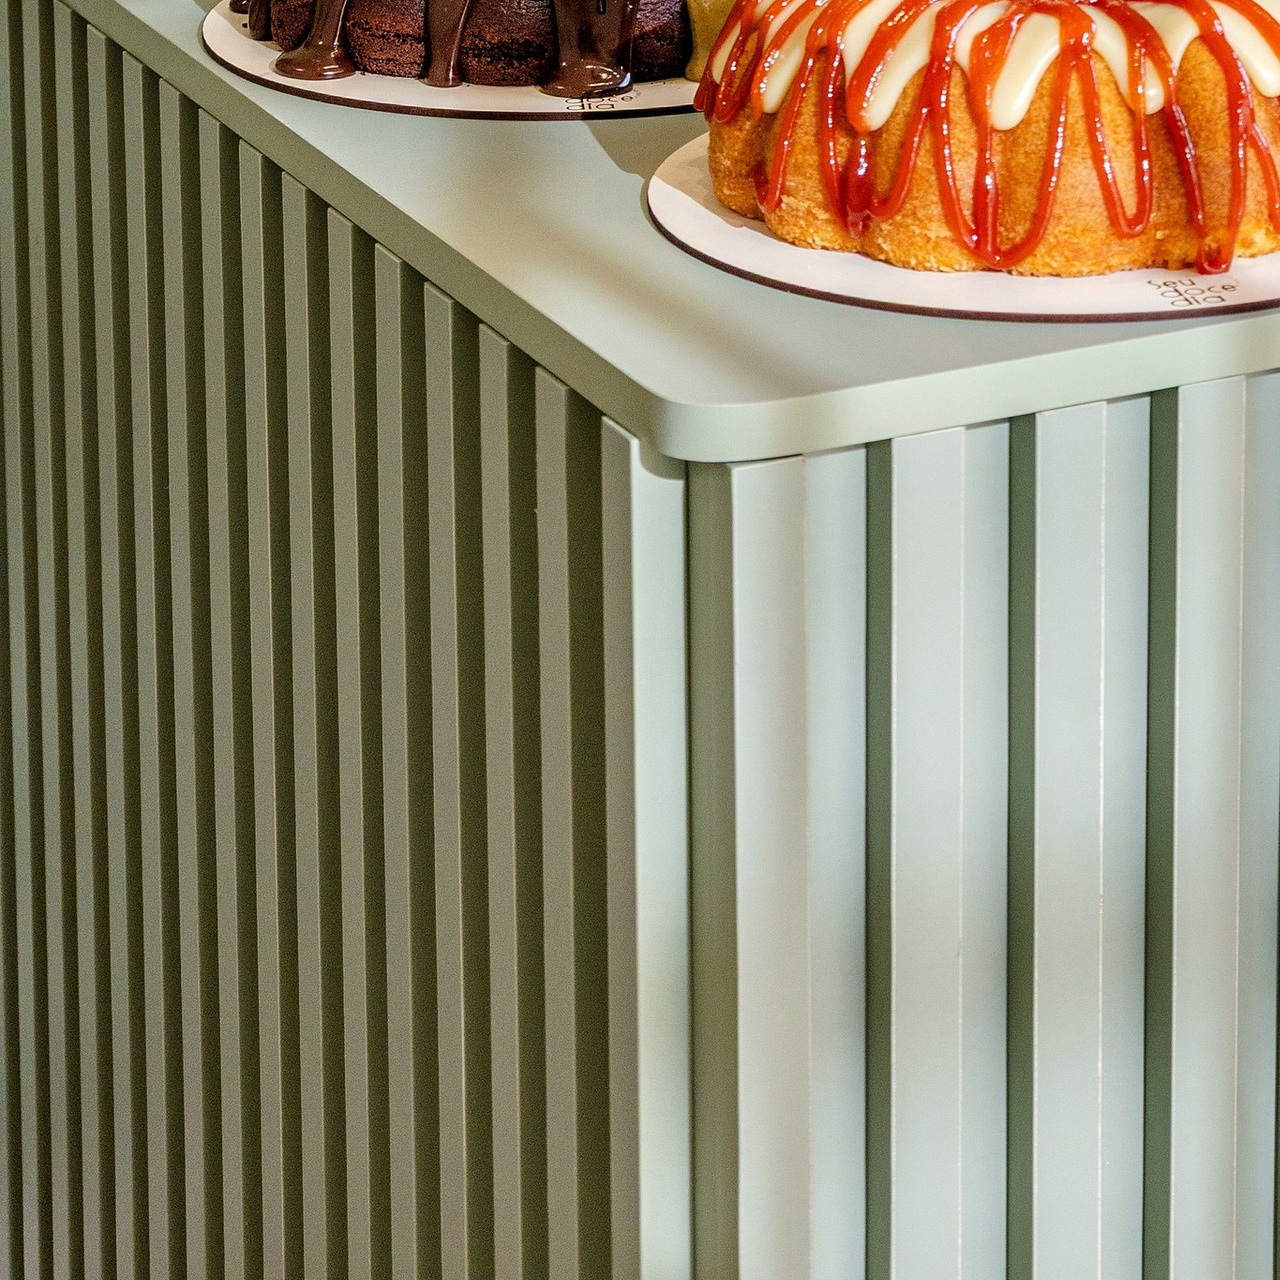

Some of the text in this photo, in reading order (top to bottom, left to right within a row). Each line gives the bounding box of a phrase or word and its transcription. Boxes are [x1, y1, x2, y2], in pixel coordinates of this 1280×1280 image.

[566, 103, 615, 111] dia
[1160, 284, 1237, 299] doce
[1170, 295, 1226, 308] dia
